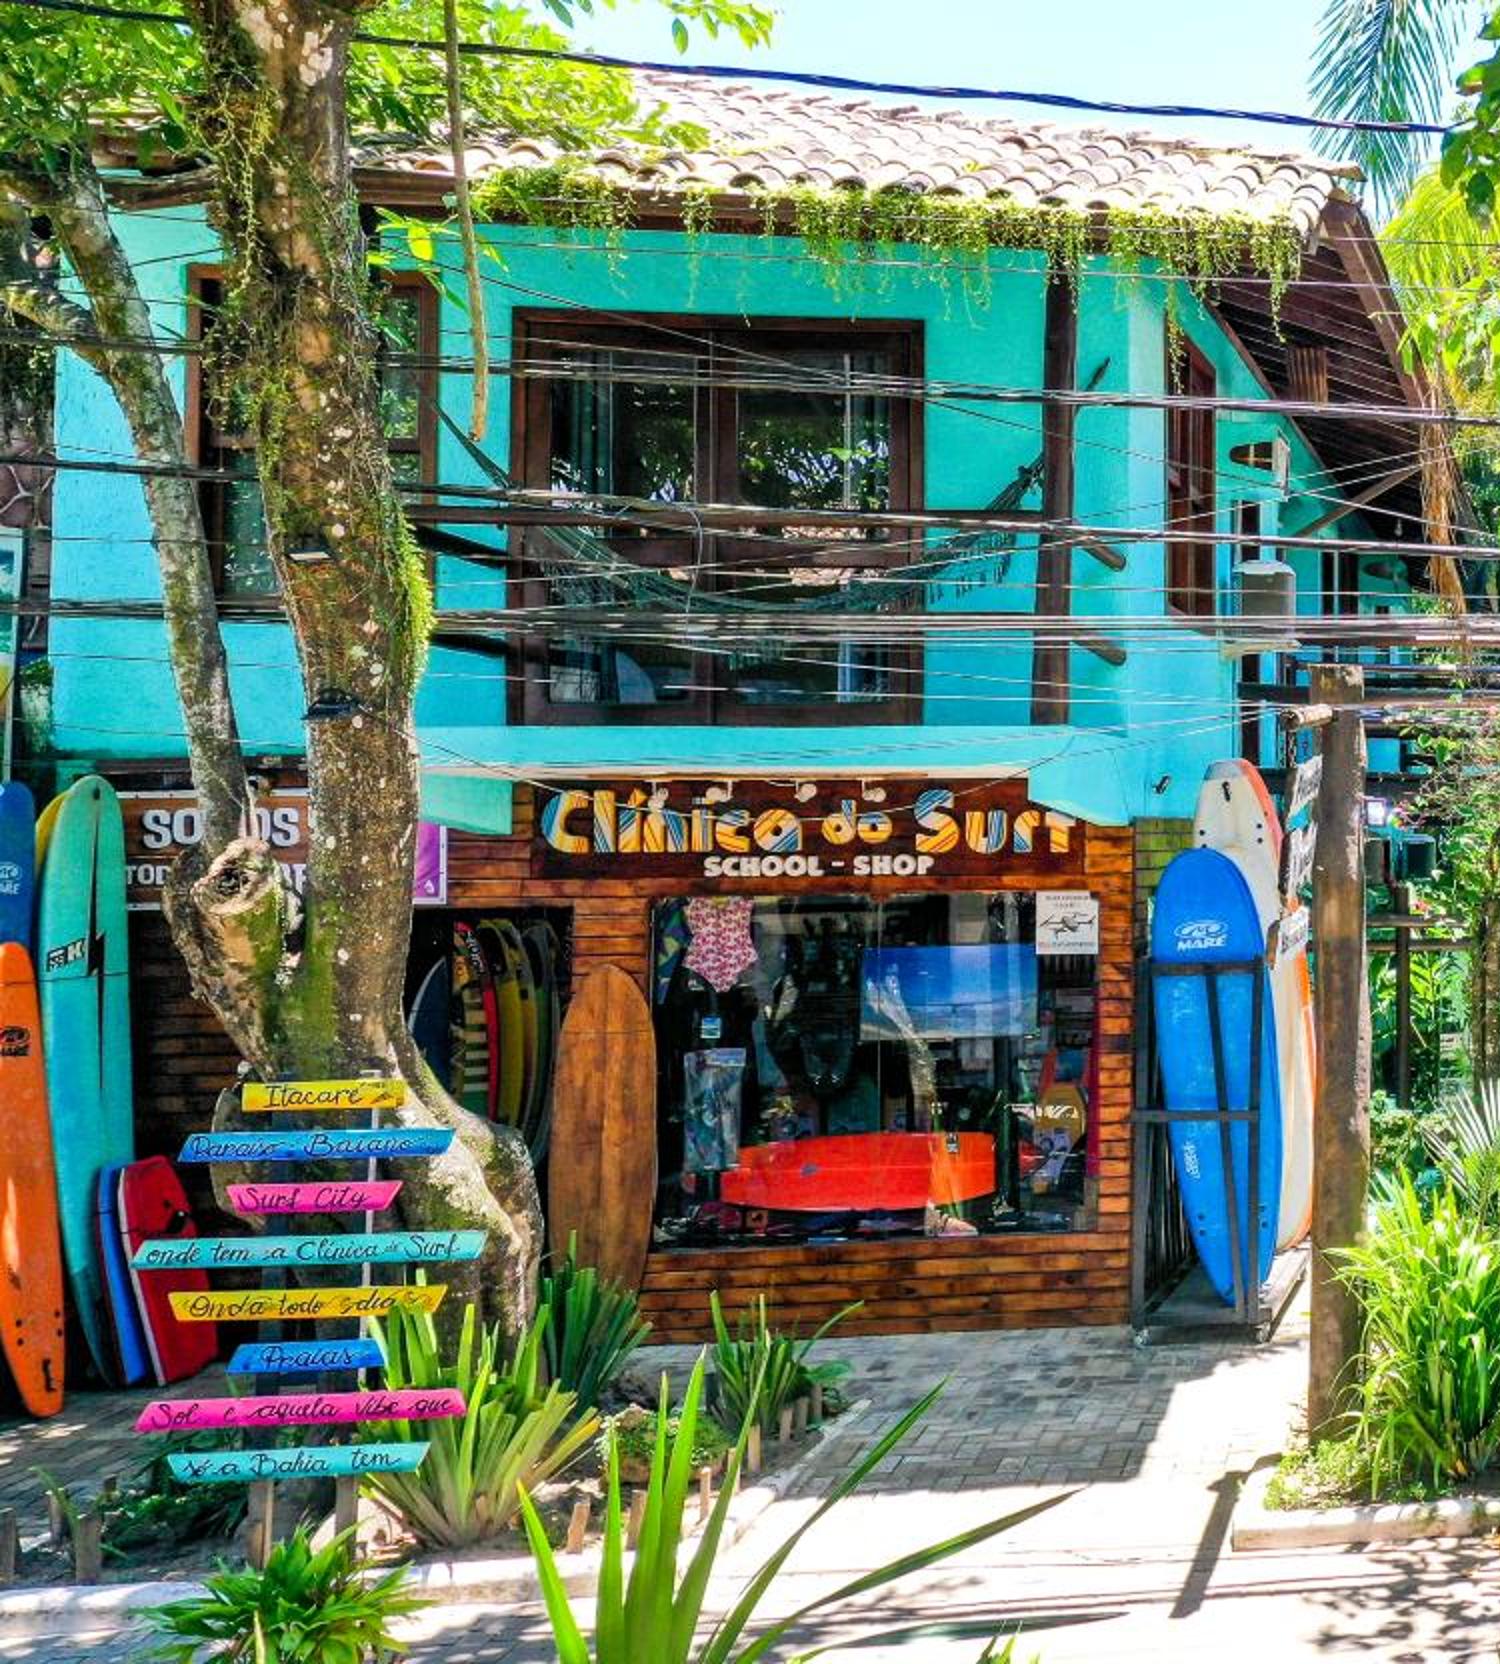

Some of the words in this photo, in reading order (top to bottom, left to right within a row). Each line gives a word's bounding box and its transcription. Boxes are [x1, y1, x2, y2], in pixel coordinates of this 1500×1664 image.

[914, 789, 1076, 854] Surf
[704, 855, 824, 877] SCHOOL
[853, 855, 935, 876] SHOP
[1177, 934, 1228, 952] MARE
[238, 1187, 300, 1211] Surf
[314, 1187, 370, 1210] City
